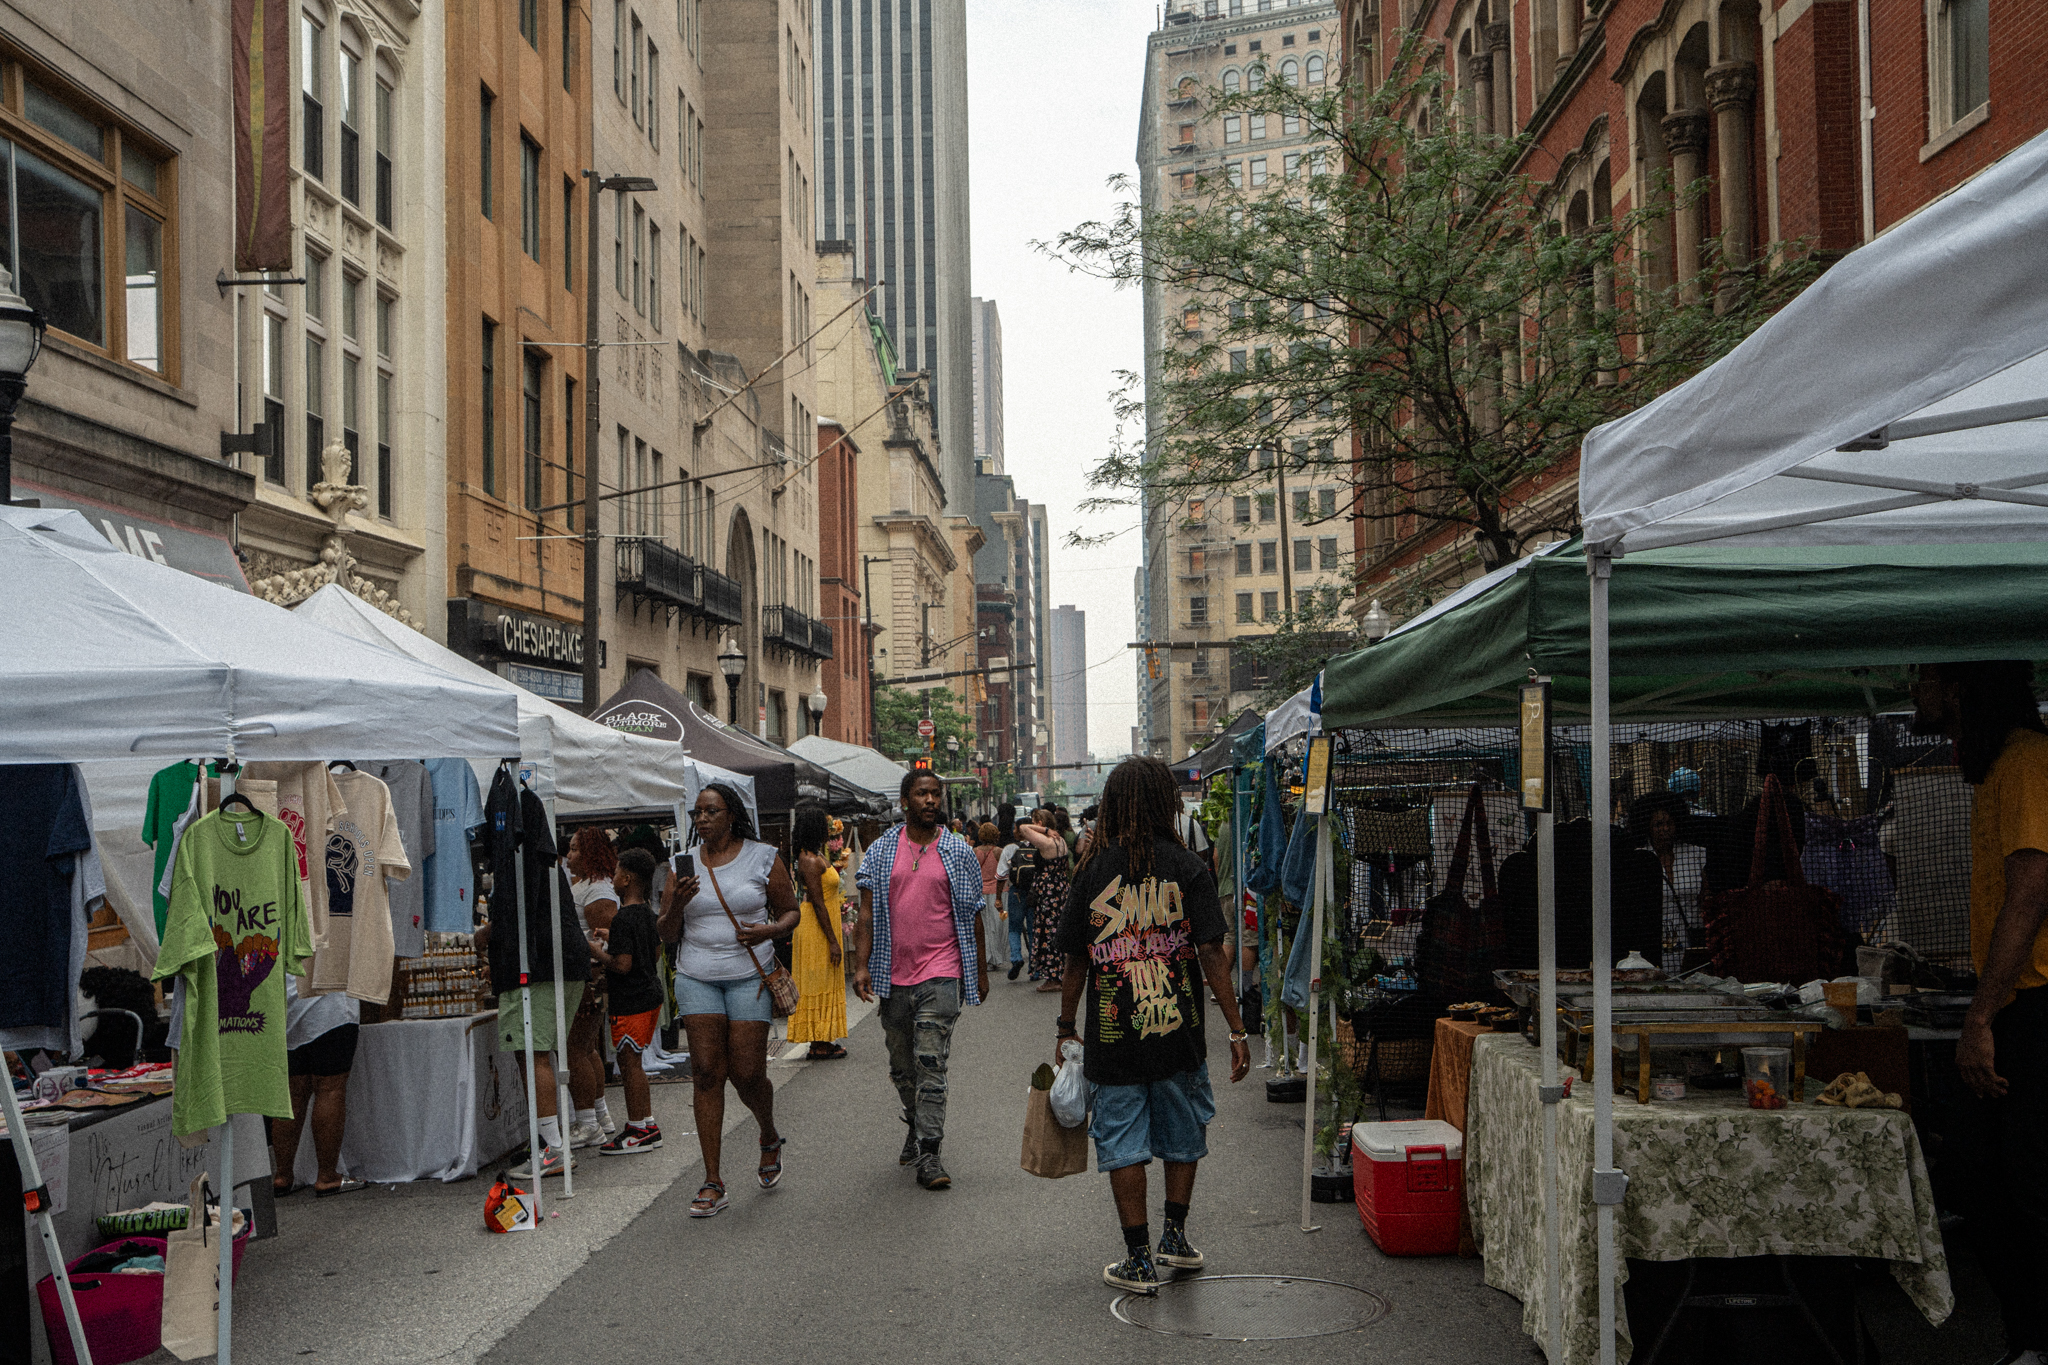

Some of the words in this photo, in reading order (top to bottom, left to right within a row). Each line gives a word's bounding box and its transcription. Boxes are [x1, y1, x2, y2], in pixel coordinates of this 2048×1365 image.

[503, 615, 582, 664] CHESAPEAKE
[604, 712, 662, 724] BLACK
[604, 719, 667, 729] ALTIMORE
[339, 821, 370, 848] SCHOOLS
[363, 850, 375, 877] OPEN
[212, 884, 241, 919] YOU
[236, 901, 279, 935] ARE
[1090, 874, 1184, 944] SMINO
[1125, 958, 1173, 1003] TOUR
[219, 1016, 261, 1030] MATIONS
[1137, 993, 1184, 1041] 2025
[91, 1139, 164, 1224] Natural
